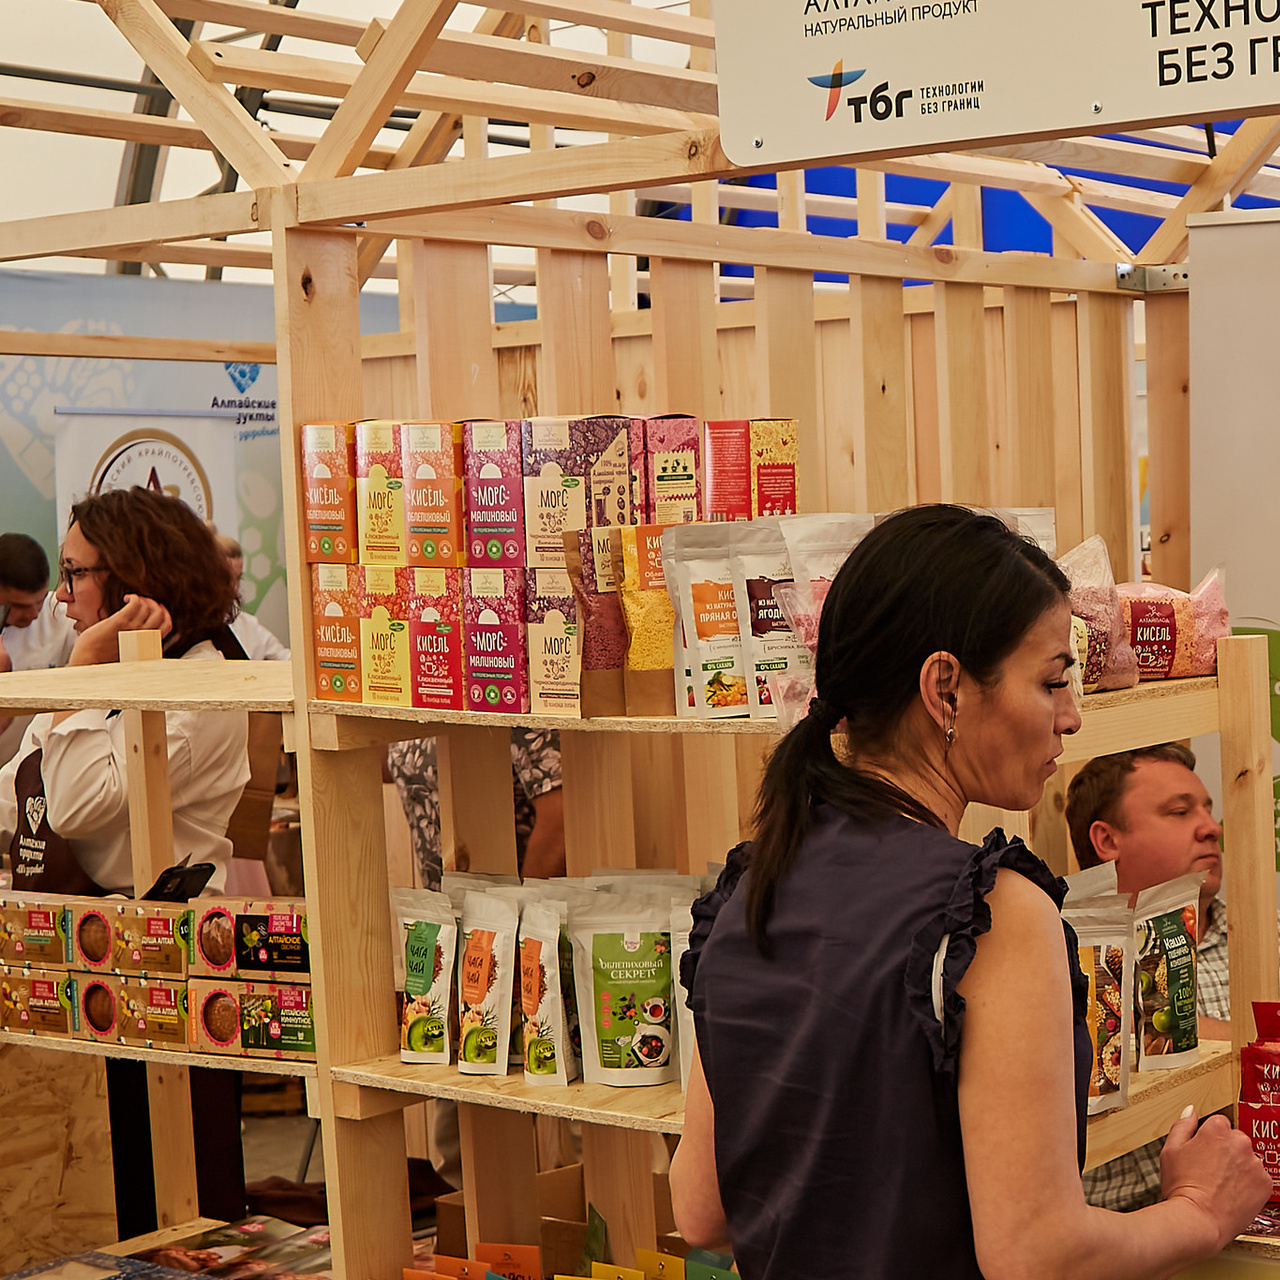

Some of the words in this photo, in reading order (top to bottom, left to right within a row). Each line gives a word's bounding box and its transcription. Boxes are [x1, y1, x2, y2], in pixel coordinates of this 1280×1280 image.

[804, 6, 907, 37] НАТУРАЛЬНЫЙ
[1157, 41, 1235, 87] БЕЗ
[921, 81, 983, 99] ТЕХНОЛОГИИ
[847, 82, 912, 123] тбг
[921, 102, 938, 114] БЕЗ
[942, 98, 980, 111] ГРАНИЦ
[211, 396, 277, 409] Алтайские
[368, 490, 393, 510] МОРС
[478, 484, 506, 506] МОРС
[540, 489, 568, 509] МОРС
[471, 509, 517, 522] МАЛИНОВЫЙ
[700, 612, 730, 623] ПРЯНАЯ
[1137, 626, 1171, 641] КИСЕЛЬ
[371, 632, 395, 651] МОРС
[417, 635, 449, 653] КИСЕЛЬ
[476, 631, 504, 653] МОРС
[544, 636, 570, 656] МОРС
[470, 654, 514, 668] МАЛИНОВЫЙ
[1163, 935, 1187, 950] Каша
[410, 945, 427, 959] ЧАГА
[408, 960, 424, 974] ЧАЙ
[468, 955, 483, 968] ЧАГА
[599, 958, 663, 969] ОБЛЕПИХОВЫЙ
[467, 971, 480, 984] ЧАЙ
[611, 968, 656, 979] СЕКРЕТ
